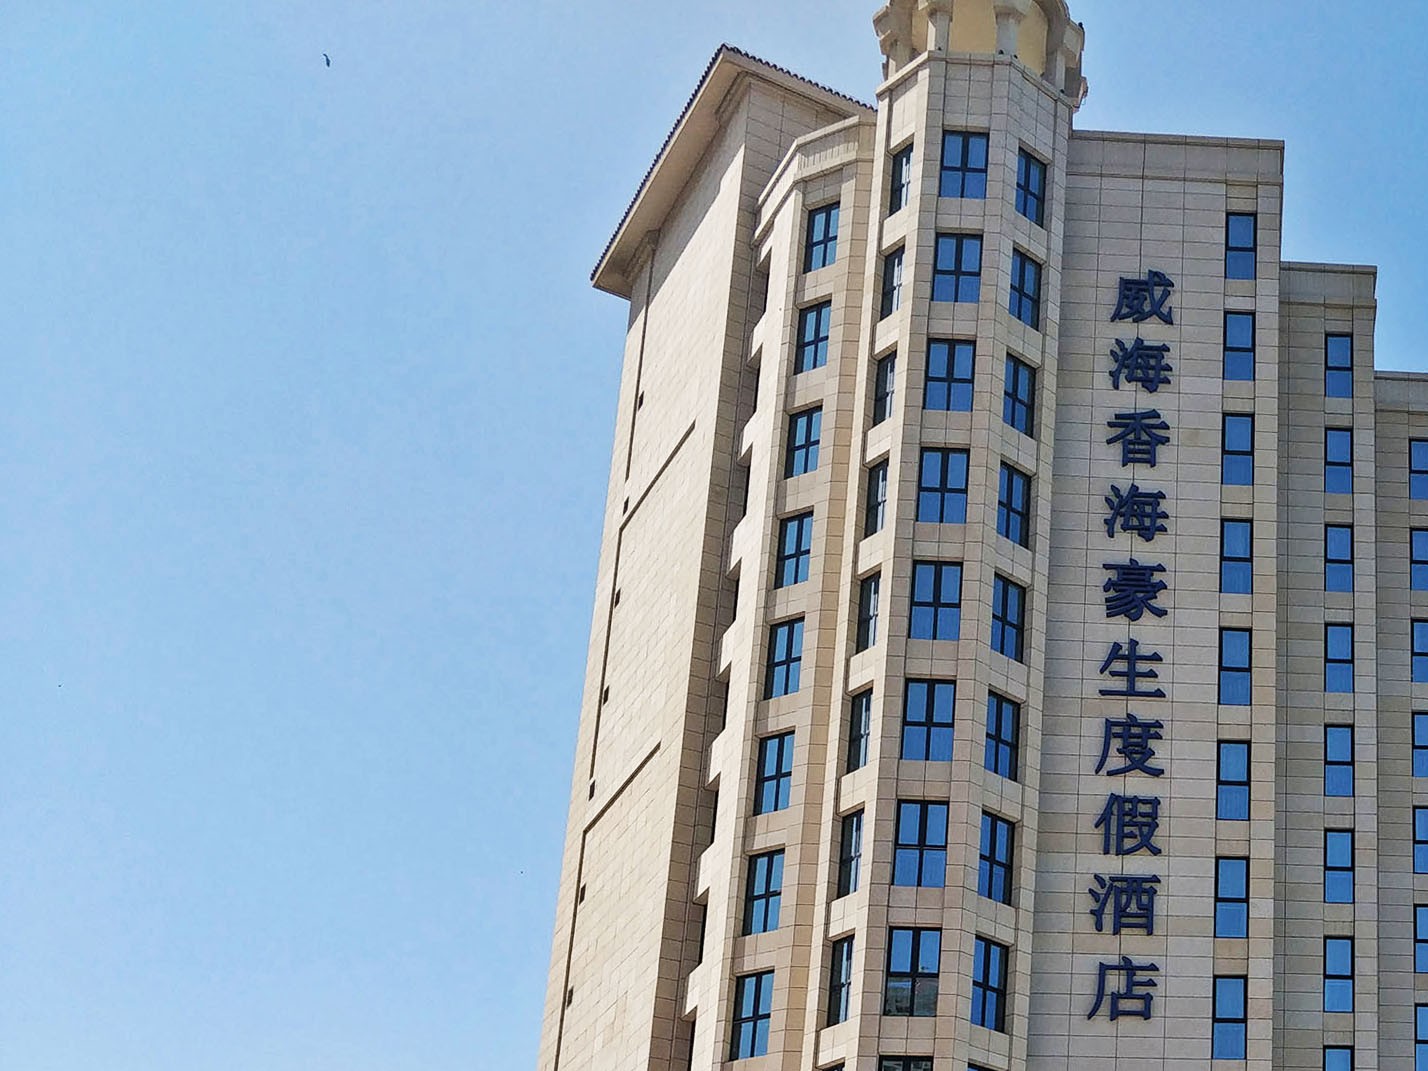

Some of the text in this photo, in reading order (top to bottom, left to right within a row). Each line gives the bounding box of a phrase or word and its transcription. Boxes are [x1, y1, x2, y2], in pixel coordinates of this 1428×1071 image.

[1087, 269, 1175, 1022] 威海香海豪生度假酒店
